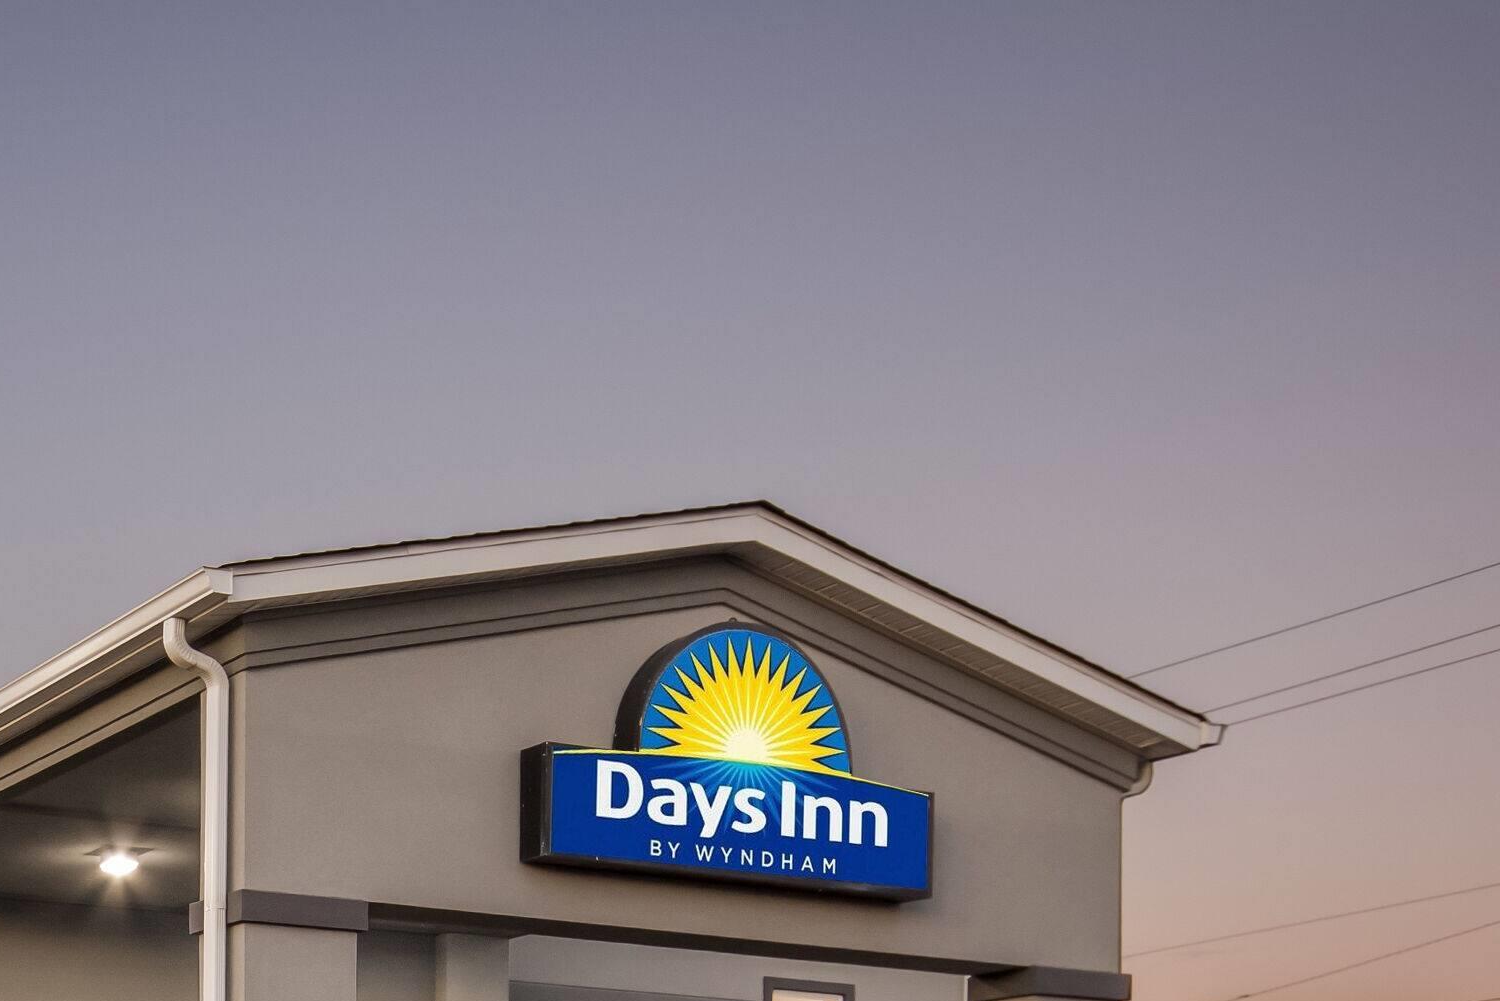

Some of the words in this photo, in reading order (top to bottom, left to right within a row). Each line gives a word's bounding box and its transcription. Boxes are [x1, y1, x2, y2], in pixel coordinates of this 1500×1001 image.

[595, 759, 768, 839] Days
[780, 780, 889, 848] Inn
[650, 839, 681, 859] BY
[695, 844, 837, 875] WYNDHAM
